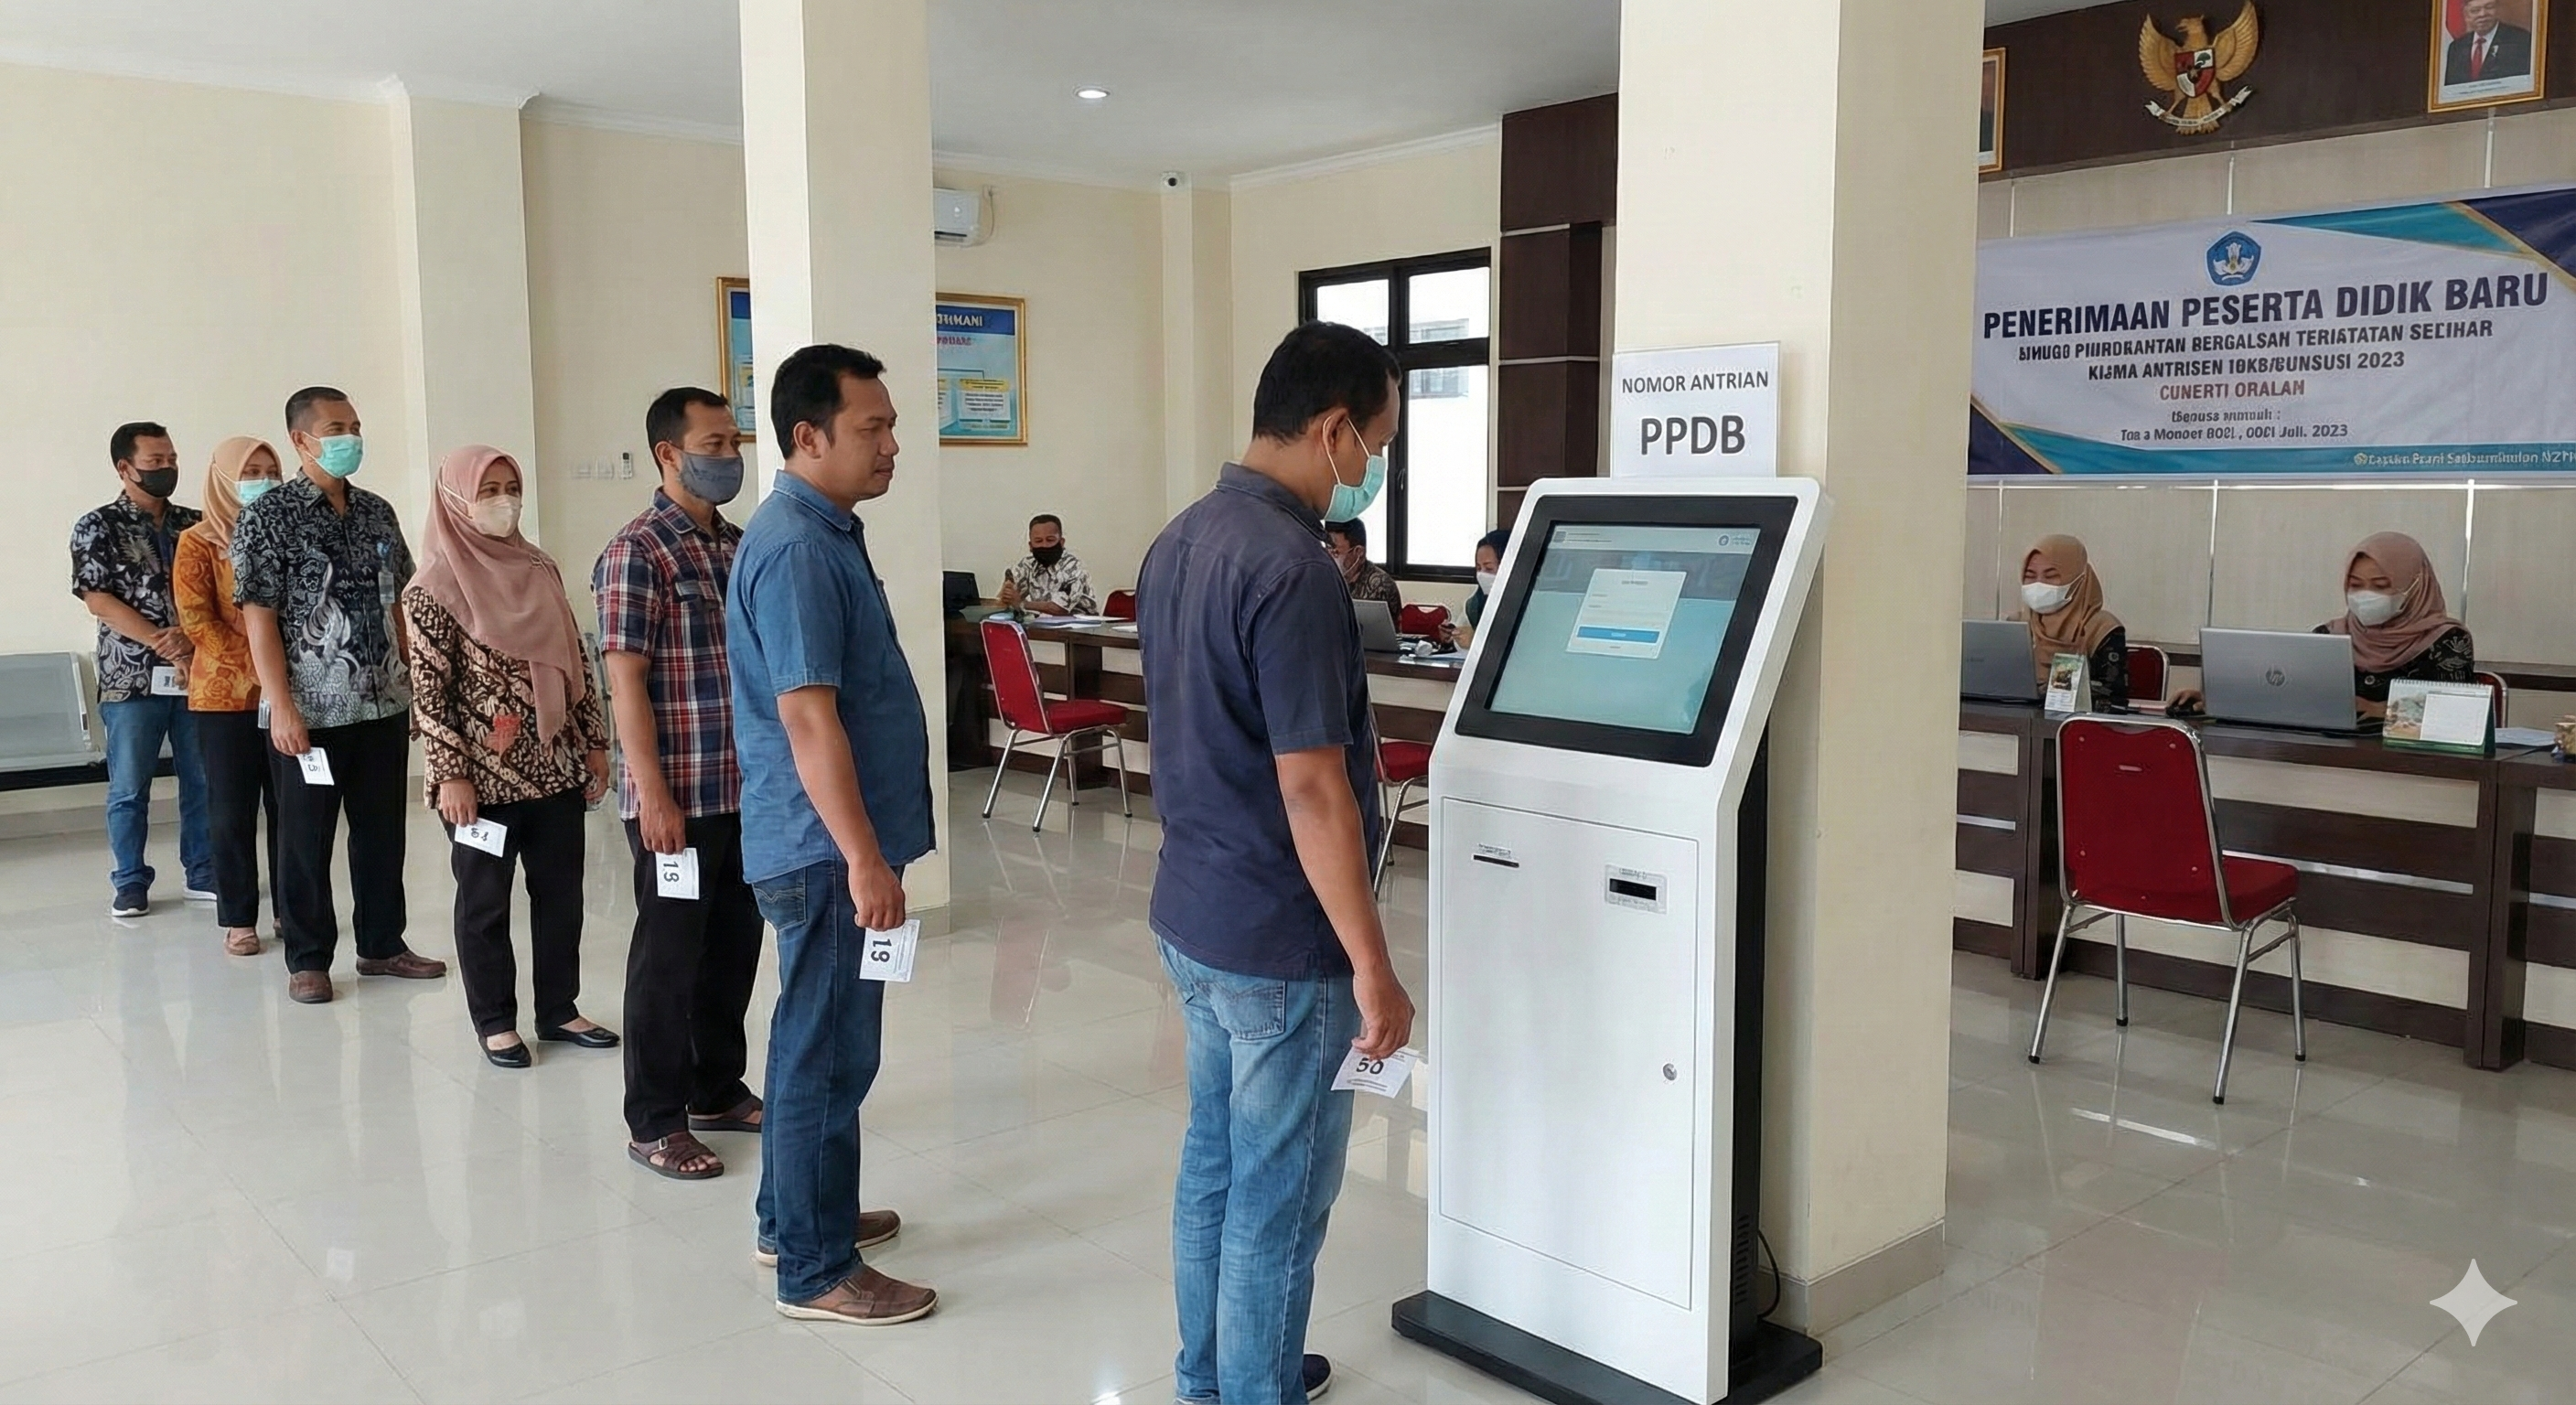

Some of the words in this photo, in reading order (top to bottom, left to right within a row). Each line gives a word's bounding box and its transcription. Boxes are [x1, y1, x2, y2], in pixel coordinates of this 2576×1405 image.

[1983, 301, 2170, 338] PENERIMAAN
[2182, 289, 2324, 328] PESERTA
[2336, 280, 2433, 318] DIDIK
[2445, 273, 2549, 310] BARU
[2142, 360, 2223, 378] ANTRISEN
[2357, 351, 2405, 369] 2023
[1622, 375, 1686, 393] NOMOR
[1690, 370, 1769, 391] ANTRIAN
[2160, 383, 2229, 401] CUNERTI
[1641, 415, 1745, 456] PPDB
[2313, 424, 2348, 436] 2023
